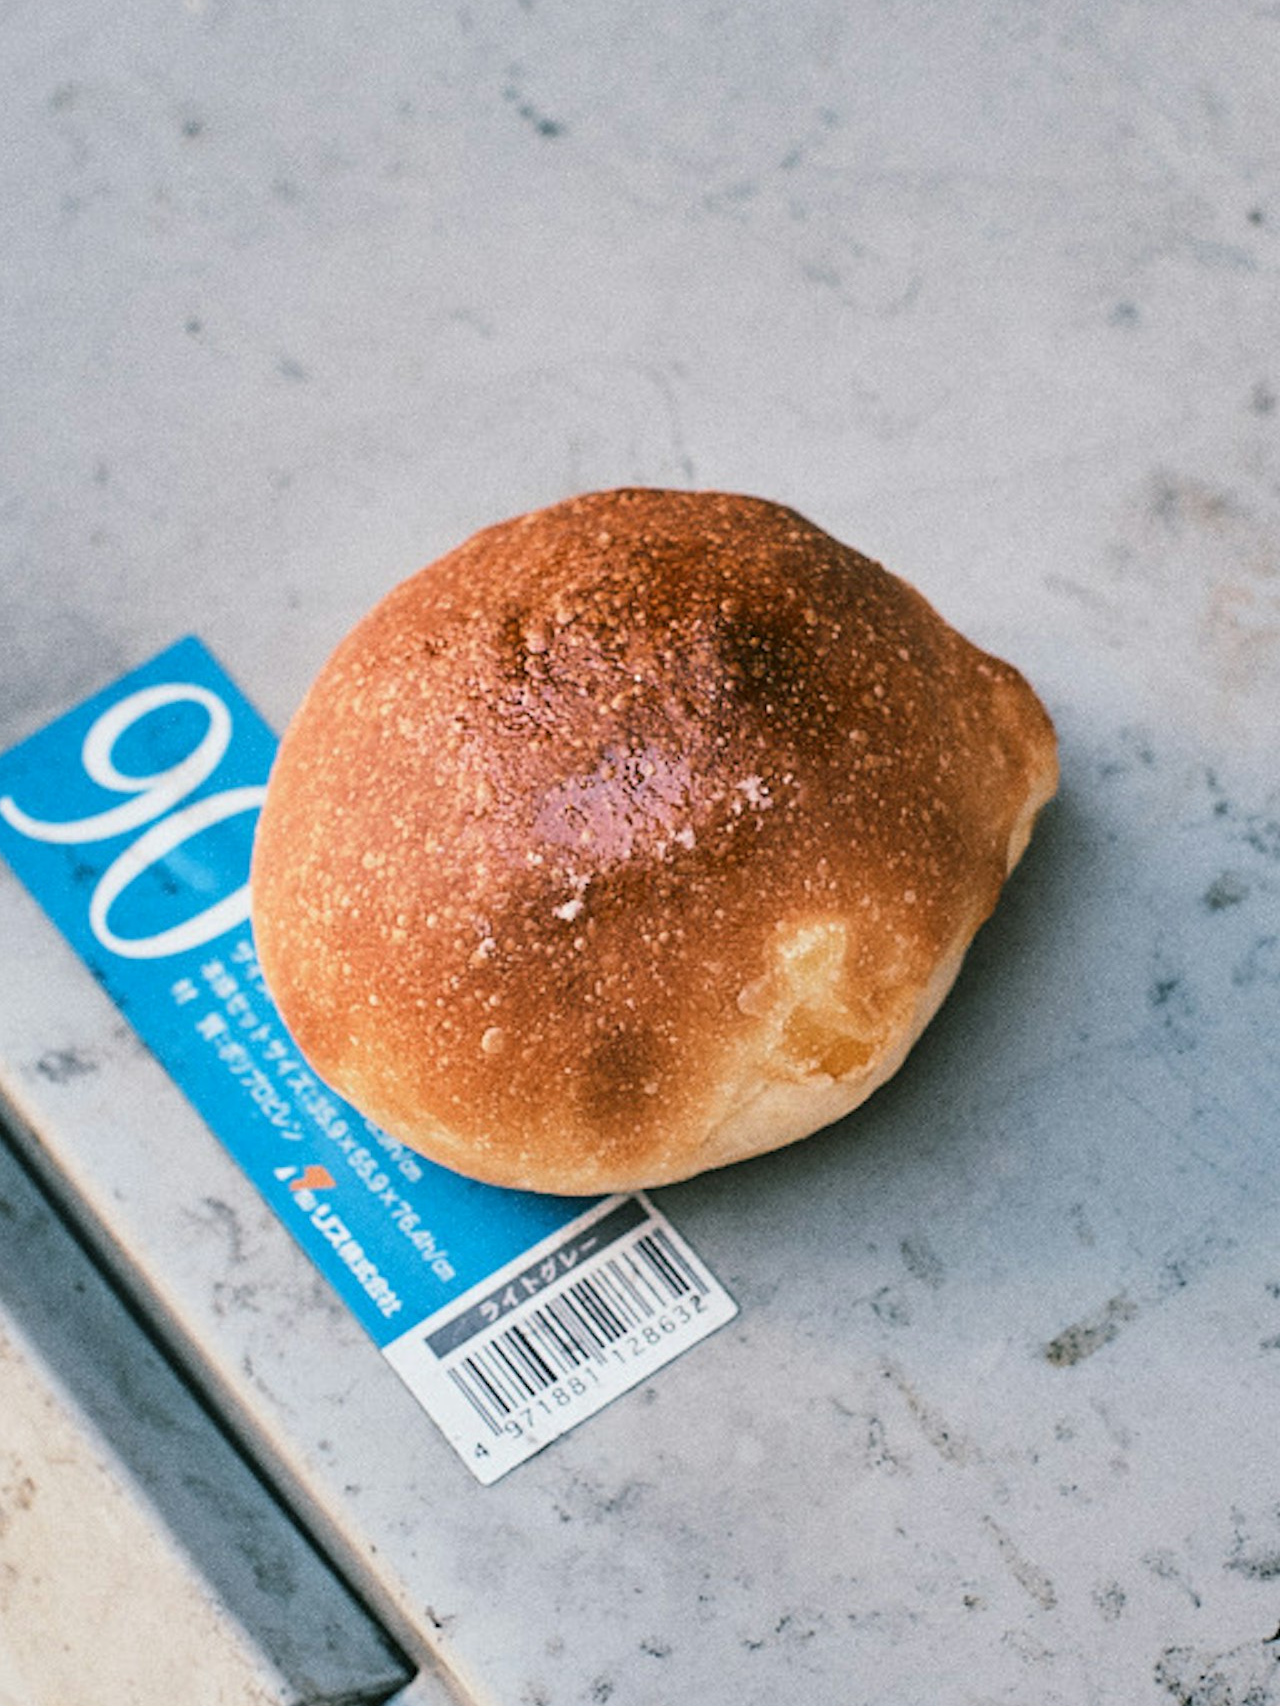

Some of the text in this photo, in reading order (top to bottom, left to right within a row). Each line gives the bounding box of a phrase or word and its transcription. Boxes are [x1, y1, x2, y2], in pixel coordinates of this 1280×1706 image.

[479, 1237, 597, 1322] ライトグレー
[473, 1294, 708, 1459] 4 971881 128632
